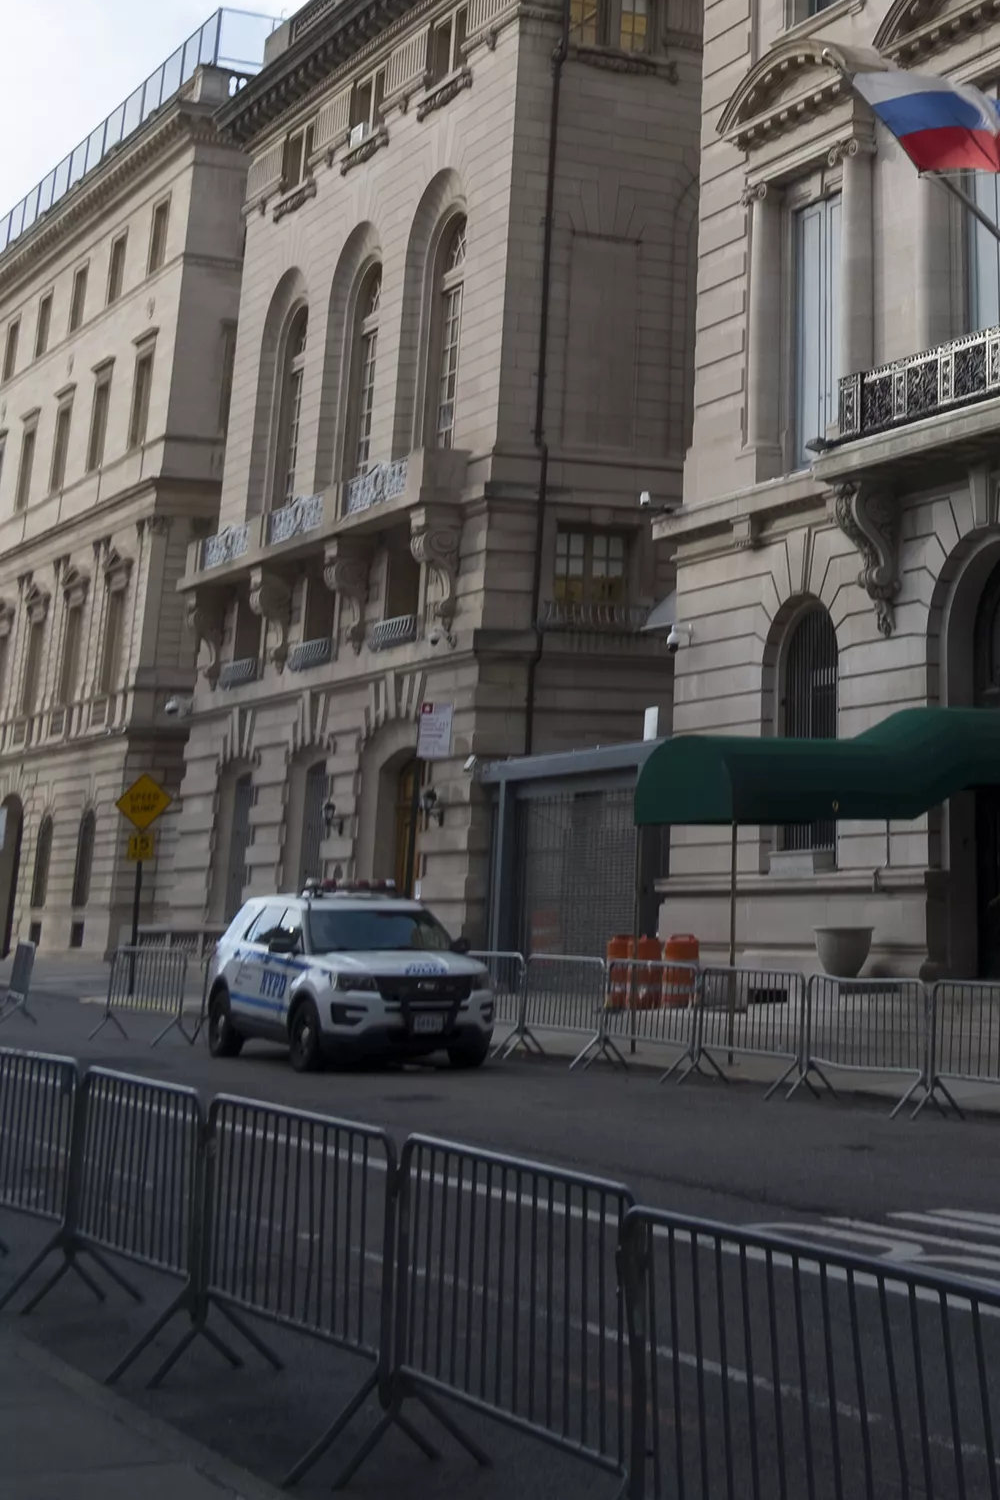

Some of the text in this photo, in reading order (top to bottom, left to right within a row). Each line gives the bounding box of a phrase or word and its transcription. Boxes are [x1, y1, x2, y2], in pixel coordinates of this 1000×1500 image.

[129, 791, 160, 803] SPEED
[133, 835, 150, 851] 15
[260, 968, 288, 999] NYPD
